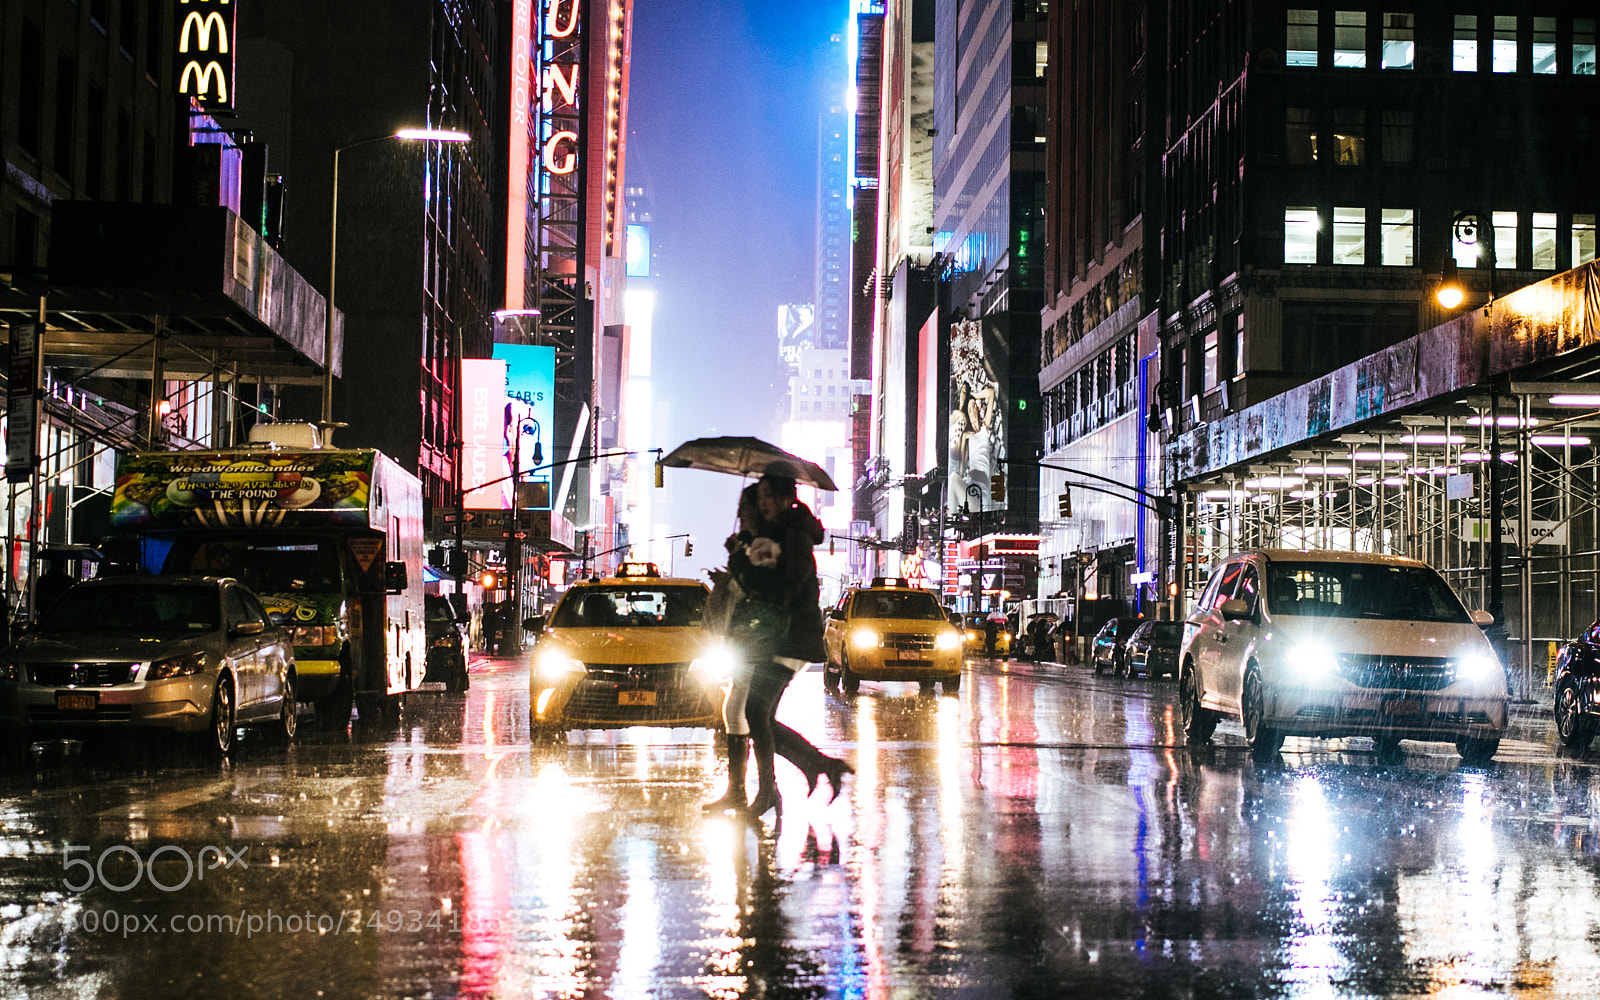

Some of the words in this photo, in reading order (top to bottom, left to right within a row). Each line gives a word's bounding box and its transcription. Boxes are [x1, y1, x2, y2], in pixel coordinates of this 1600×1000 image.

[514, 35, 527, 125] COLOR
[211, 490, 235, 499] THE
[238, 489, 278, 499] POUND
[472, 434, 487, 495] LAUDER
